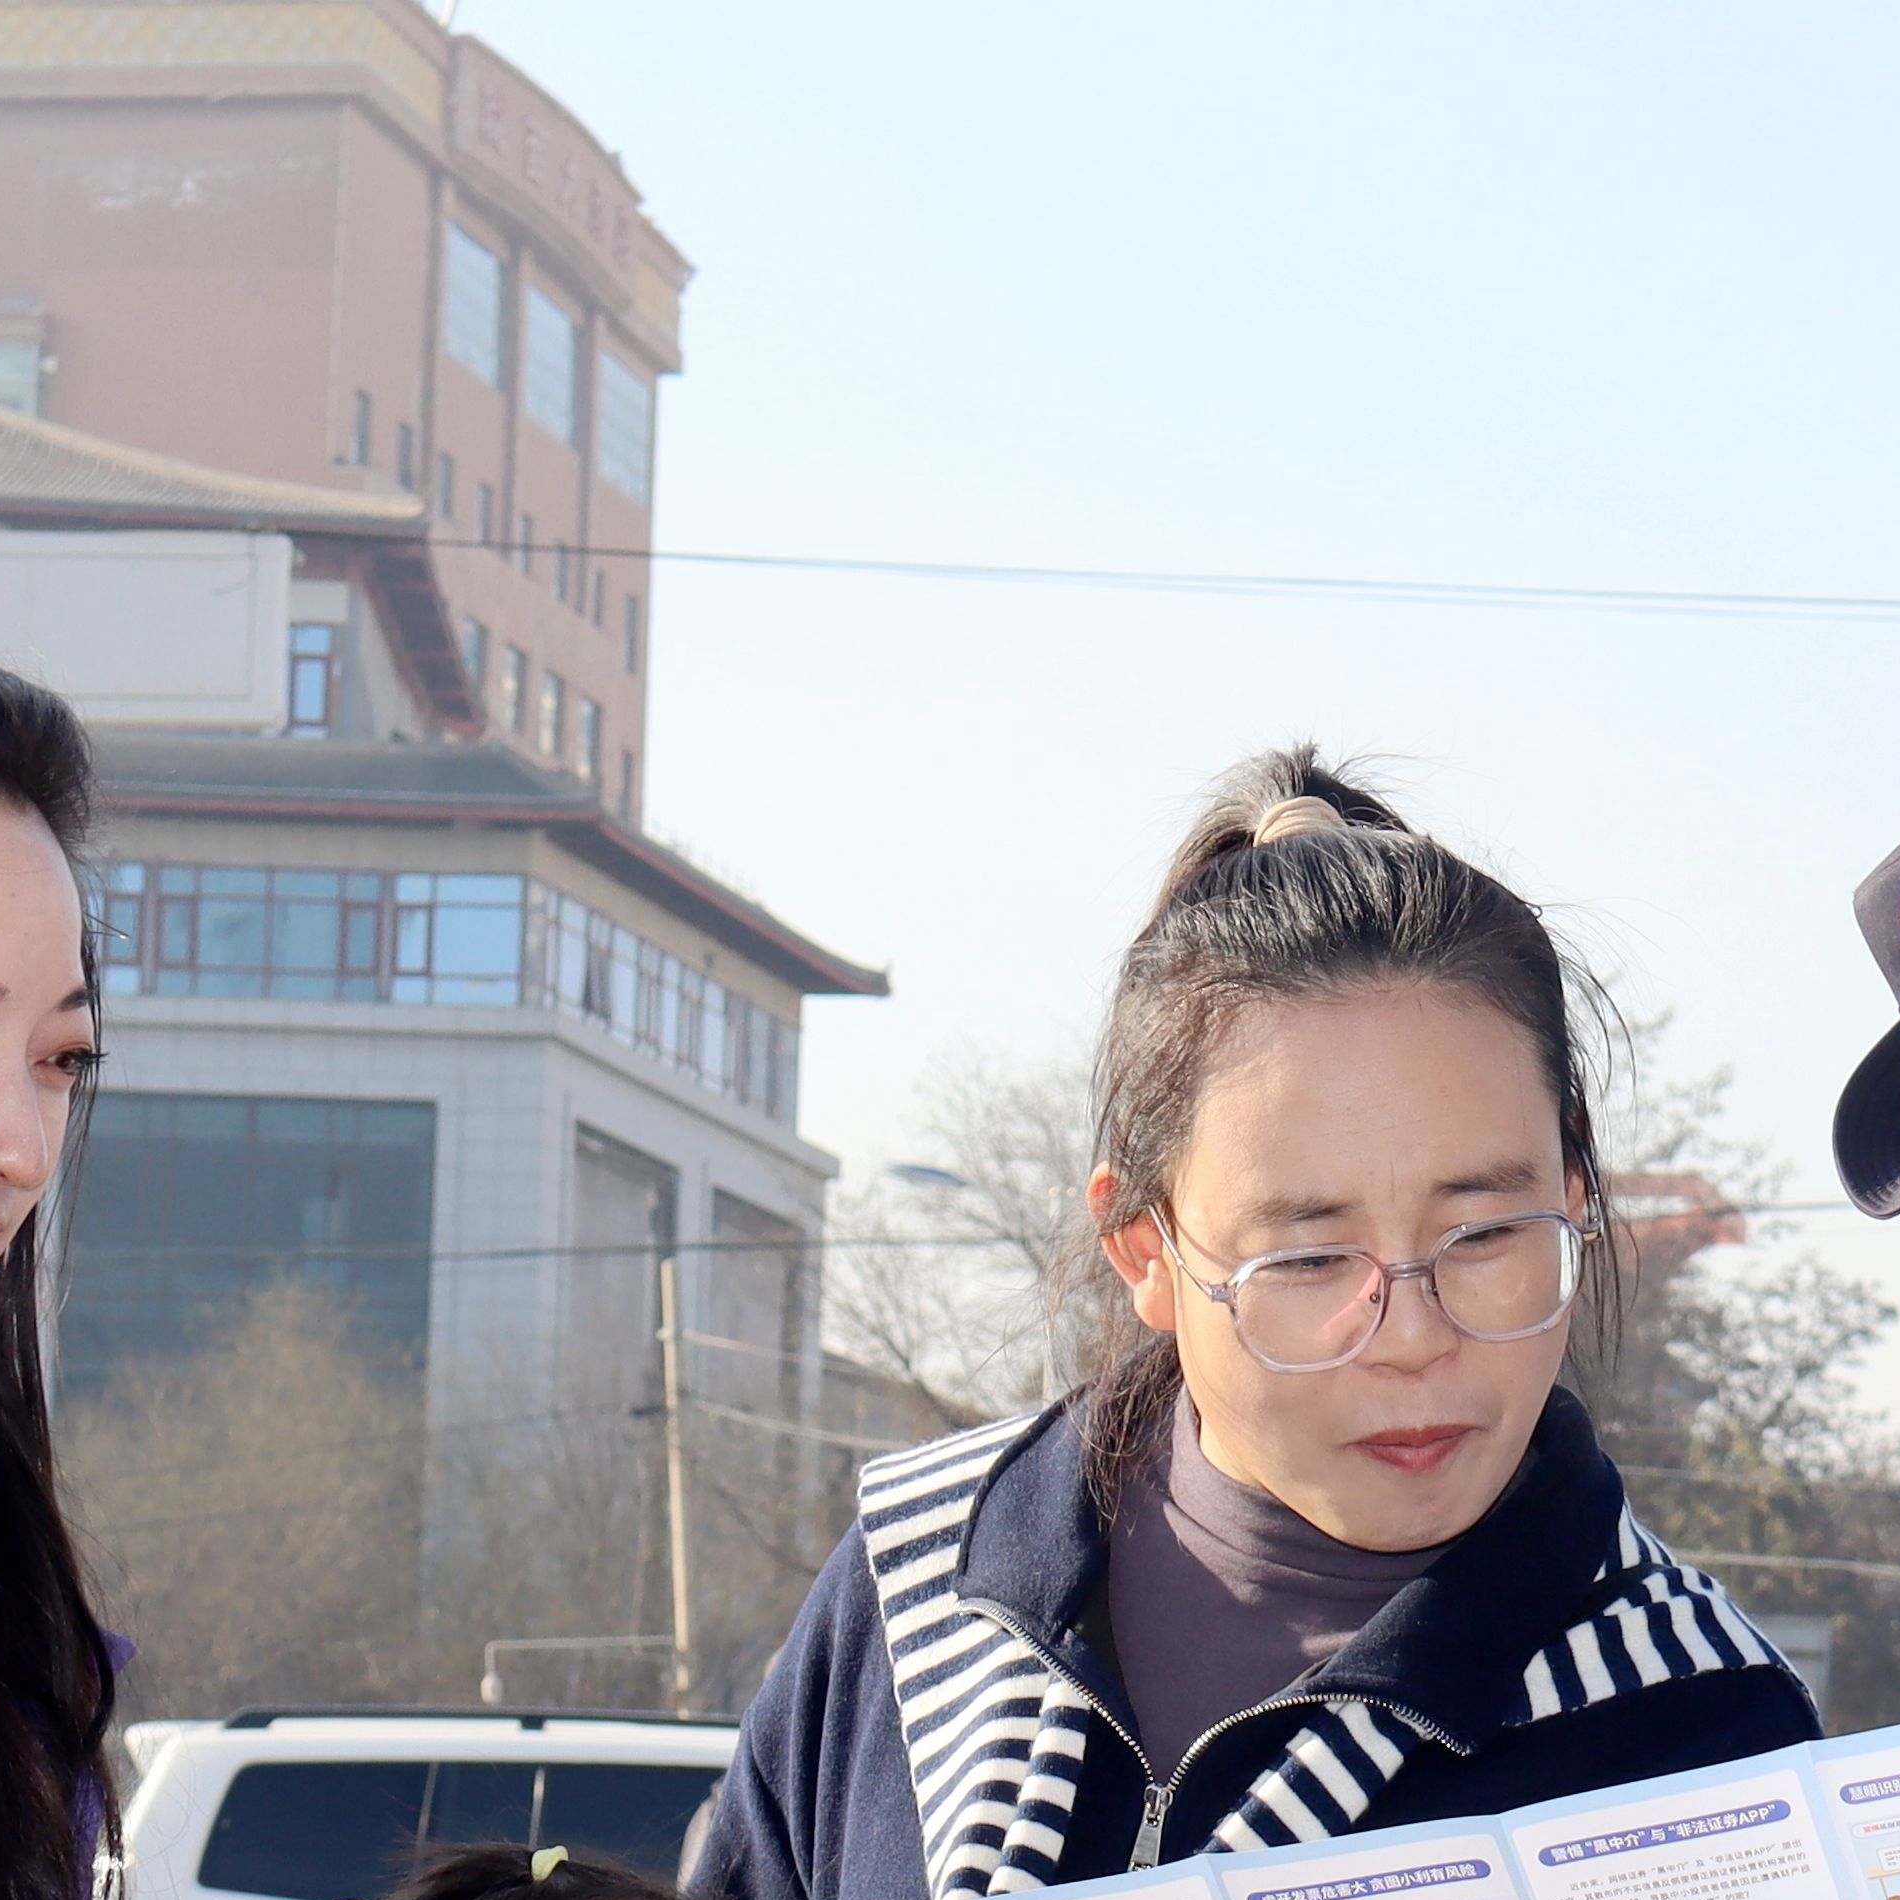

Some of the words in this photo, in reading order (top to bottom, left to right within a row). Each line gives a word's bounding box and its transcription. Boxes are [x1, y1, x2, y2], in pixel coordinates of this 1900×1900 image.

[1370, 1864, 1477, 1892] 贪图小利有风险
